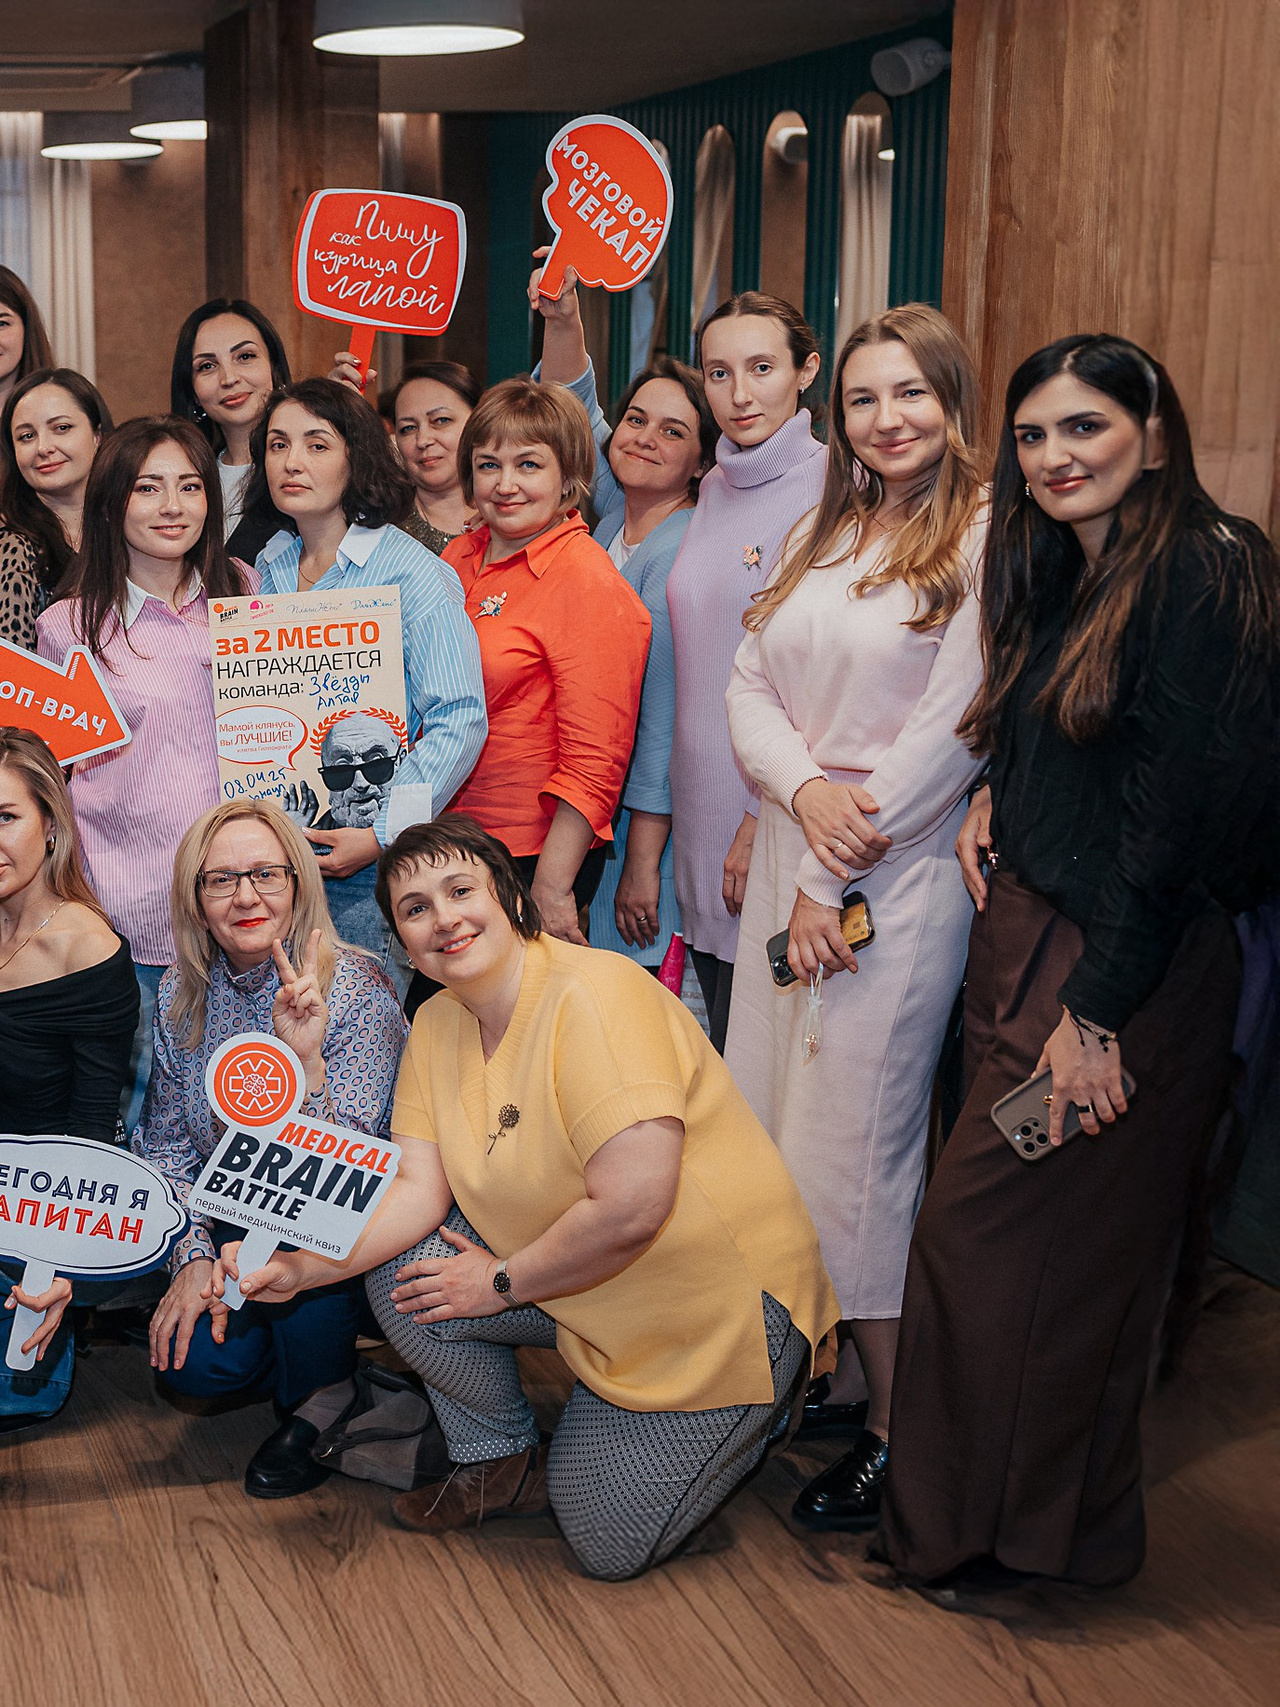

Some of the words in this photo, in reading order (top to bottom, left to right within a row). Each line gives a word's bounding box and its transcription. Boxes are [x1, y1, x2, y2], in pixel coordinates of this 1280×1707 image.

[556, 135, 664, 242] МОЗГОВОЙ
[329, 232, 362, 246] как
[355, 200, 444, 279] Пишу
[567, 178, 651, 272] ЧЕКАП
[314, 249, 397, 278] курица
[327, 275, 445, 314] лапой
[220, 608, 239, 619] BRAIN
[216, 636, 248, 656] за
[254, 629, 272, 653] 2
[278, 621, 380, 650] МЕСТО
[217, 650, 381, 679] НАГРАЖДАЕТСЯ
[219, 682, 304, 700] команда:
[219, 722, 253, 733] Мамой
[255, 720, 295, 731] клянусь,
[235, 730, 292, 745] ЛУЧШИЕ!
[276, 1121, 392, 1174] MEDICAL
[217, 1131, 384, 1214] BRAIN
[129, 1189, 150, 1210] Я
[203, 1170, 307, 1221] BATTLE
[195, 1197, 237, 1218] первый
[237, 1213, 313, 1244] медицинский
[315, 1238, 341, 1254] квиз
